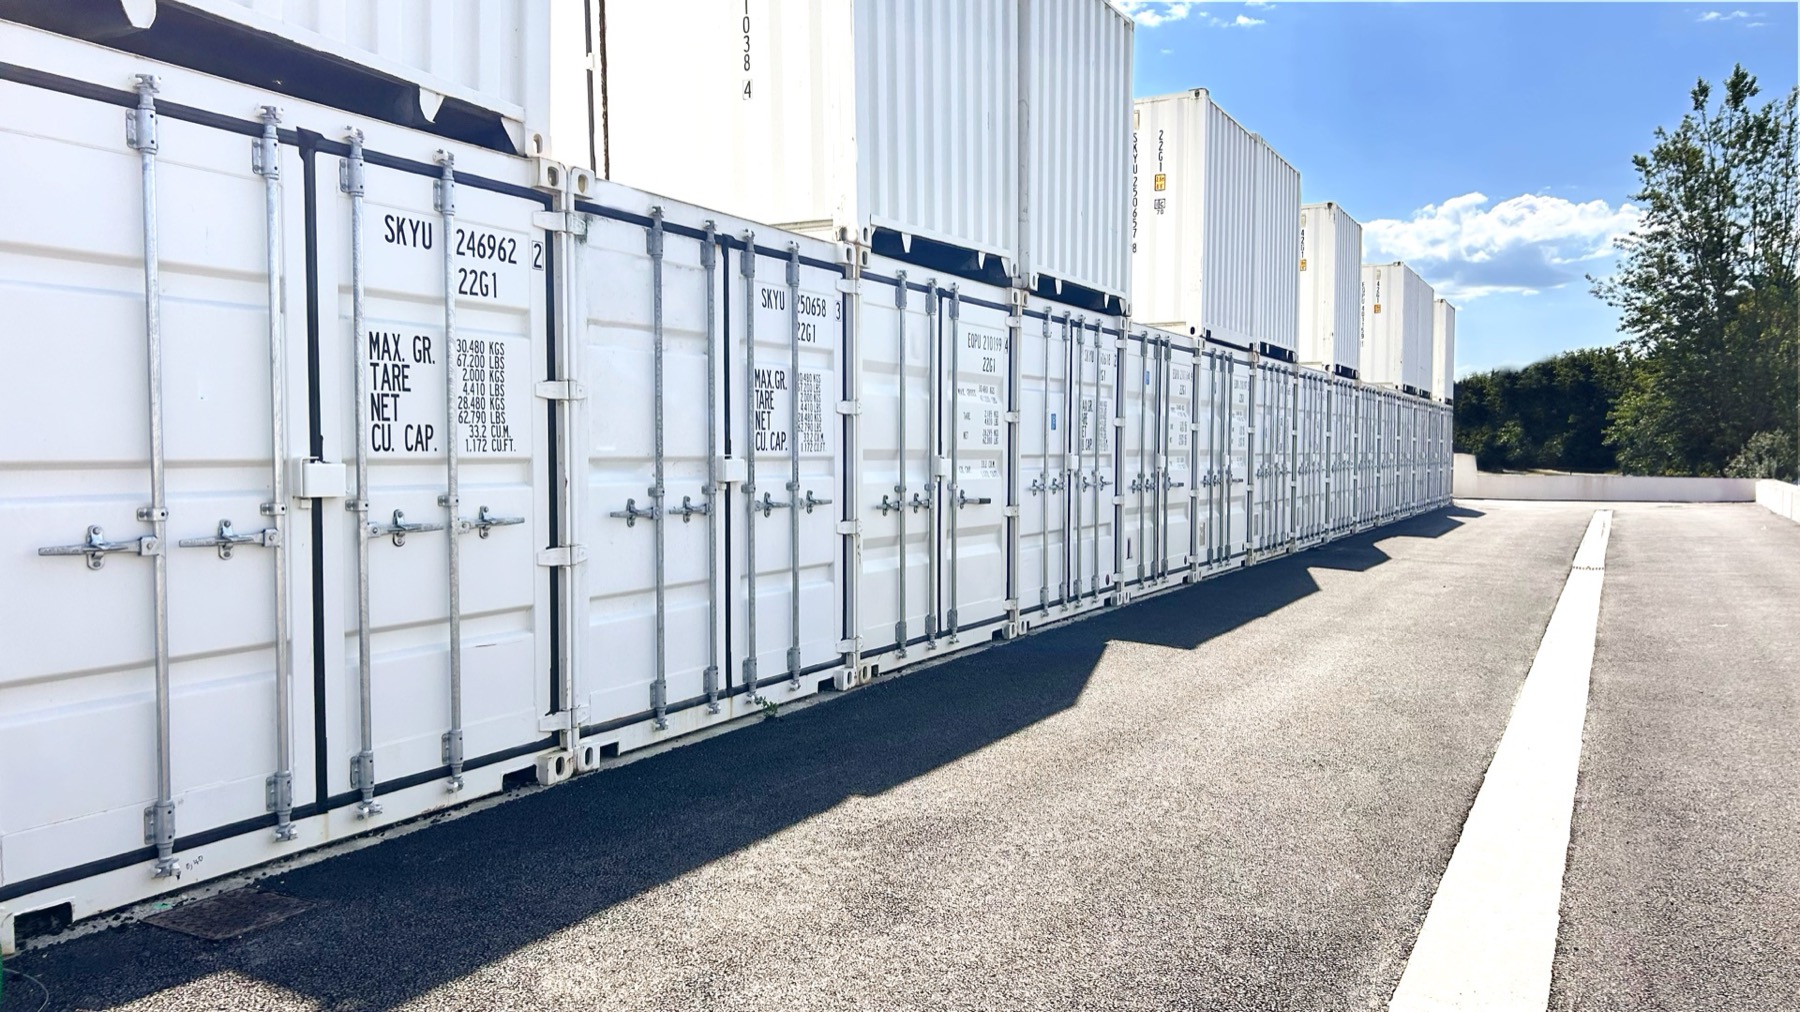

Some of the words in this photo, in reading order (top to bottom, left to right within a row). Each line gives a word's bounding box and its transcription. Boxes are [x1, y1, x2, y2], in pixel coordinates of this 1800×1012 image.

[744, 80, 751, 98] 4
[384, 214, 432, 250] SKYU
[456, 228, 518, 264] 246962
[533, 243, 542, 268] 2
[458, 268, 498, 298] 22G1
[762, 288, 786, 310] SKYU
[836, 301, 841, 320] 3
[368, 331, 405, 362] MAX.
[412, 335, 436, 364] GR.
[456, 338, 485, 354] 30.480
[489, 341, 504, 356] KGS
[968, 332, 982, 349] EQPU
[456, 354, 485, 368] 67.200
[490, 356, 504, 370] LBS
[982, 356, 996, 373] 22G1
[370, 362, 412, 392] TARE
[462, 368, 485, 382] 2.000
[490, 370, 504, 384] KGS
[754, 369, 774, 389] MAX.
[774, 370, 788, 390] GR.
[462, 382, 486, 396] 4.410
[490, 383, 504, 396] LBS
[370, 392, 400, 422] NET
[458, 396, 486, 410] 28.480
[490, 397, 506, 410] KGS
[755, 390, 774, 410] TARE
[458, 410, 486, 424] 62.790
[490, 411, 506, 424] LBS
[756, 410, 771, 430] NET
[372, 423, 394, 452] CU.
[404, 424, 437, 452] CAP.
[470, 424, 486, 438] 33.2
[466, 438, 487, 452] 1.172
[756, 431, 768, 451] CU.
[770, 431, 788, 451] CAP.
